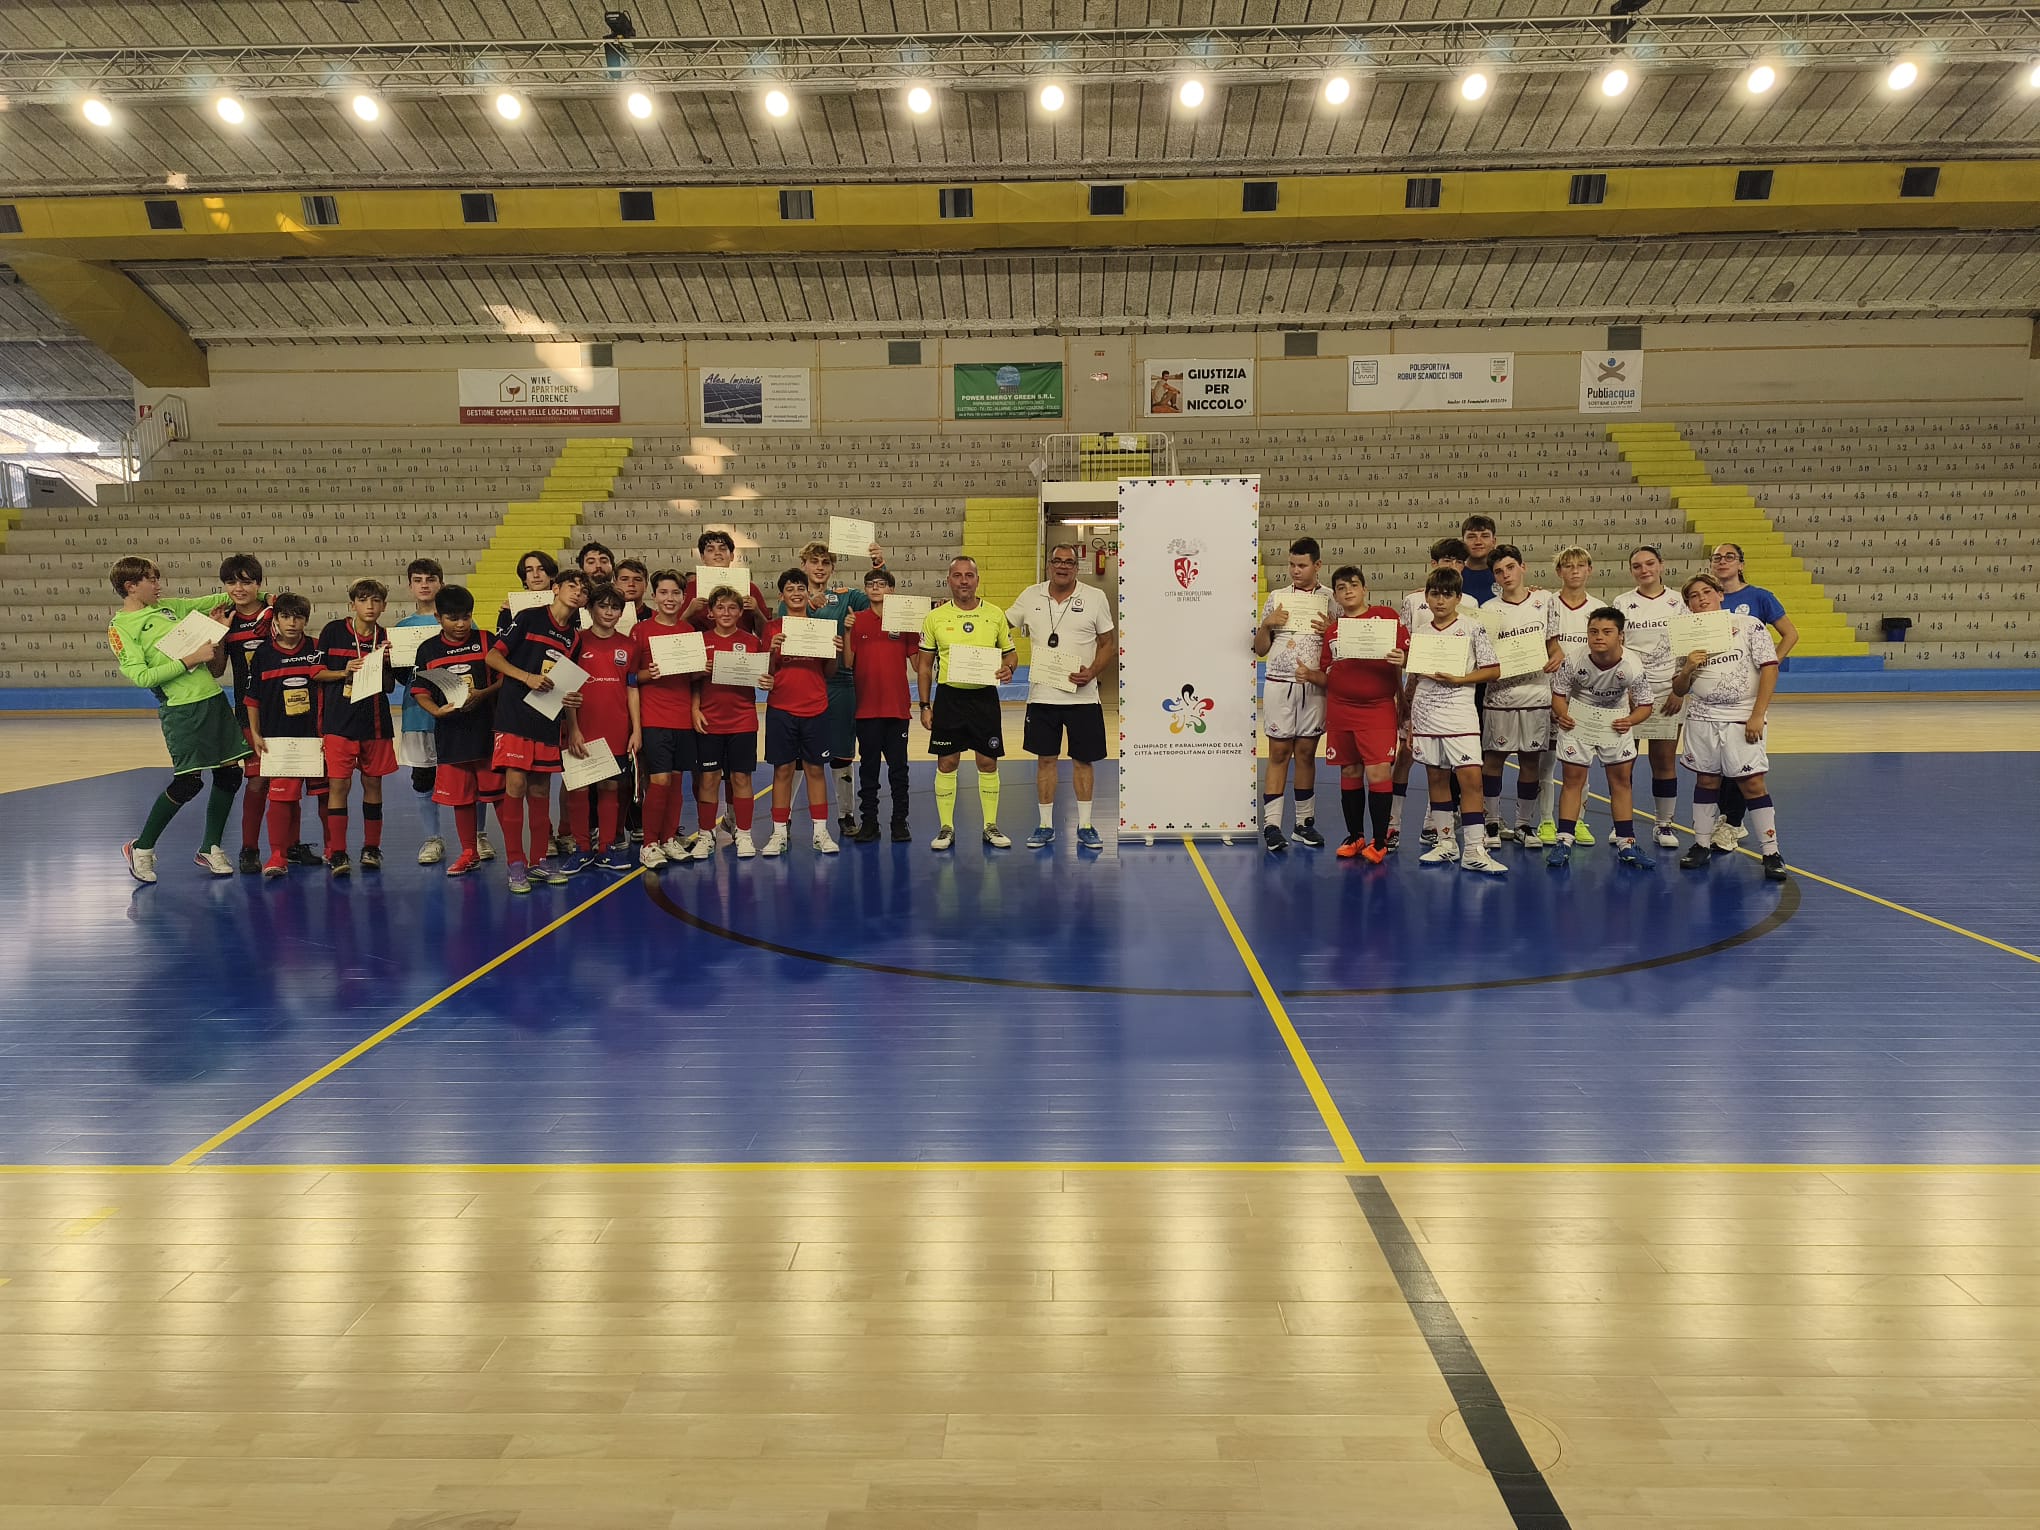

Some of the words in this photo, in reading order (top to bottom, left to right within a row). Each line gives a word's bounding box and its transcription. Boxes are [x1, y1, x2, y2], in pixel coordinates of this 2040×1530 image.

[1188, 368, 1246, 379] GIUSTIZIA
[530, 376, 552, 384] WINE
[531, 386, 578, 394] APARTMENTS
[1206, 384, 1230, 394] PER
[531, 394, 569, 403] FLORENCE
[1588, 388, 1636, 400] Publiacqua
[1187, 399, 1246, 410] NICCOLO'
[1288, 500, 1299, 508] 29
[593, 510, 604, 518] 16
[1510, 519, 1522, 528] 35
[1572, 518, 1584, 527] 37
[1603, 518, 1616, 526] 38
[1775, 515, 1786, 524] 41
[1807, 515, 1820, 523] 42
[1325, 522, 1337, 530] 29
[412, 534, 423, 542] 12
[443, 534, 455, 542] 13
[582, 533, 593, 542] 15
[746, 531, 757, 540] 20
[910, 530, 921, 538] 25
[314, 535, 327, 544] 09
[1794, 539, 1805, 548] 41
[1861, 539, 1873, 548] 43
[1928, 538, 1941, 546] 45
[1332, 546, 1344, 555] 29
[1395, 546, 1406, 555] 31
[1521, 544, 1534, 552] 35
[770, 554, 782, 563] 21
[905, 553, 916, 562] 25
[939, 553, 951, 561] 26
[265, 560, 277, 568] 08
[330, 559, 342, 568] 10
[1812, 566, 1825, 577] 41
[1847, 565, 1860, 575] 42
[1882, 566, 1895, 574] 43
[1917, 565, 1929, 573] 44
[1986, 564, 1999, 573] 46
[1371, 572, 1384, 581] 30
[1403, 572, 1415, 580] 31
[900, 579, 913, 588] 25
[79, 587, 91, 595] 03
[312, 585, 323, 593] 10
[1834, 593, 1847, 602] 41
[1870, 592, 1883, 602] 42
[1941, 592, 1954, 601] 44
[2012, 592, 2026, 600] 46
[1857, 622, 1869, 631] 41
[1930, 621, 1943, 631] 43
[2004, 621, 2016, 630] 45
[27, 641, 40, 650] 03
[1916, 651, 1930, 660] 42
[1952, 651, 1965, 660] 43
[2024, 650, 2037, 659] 45
